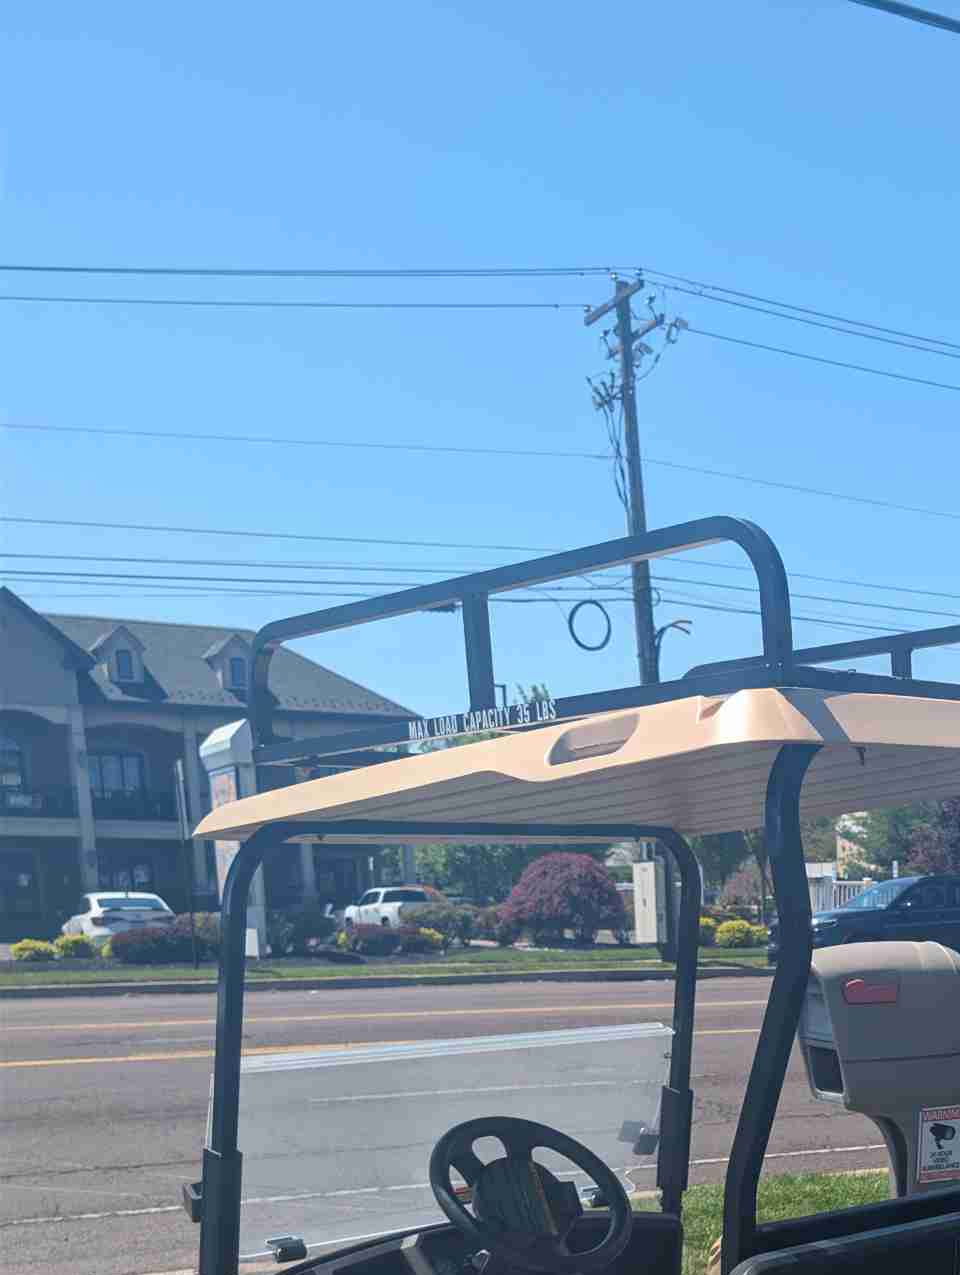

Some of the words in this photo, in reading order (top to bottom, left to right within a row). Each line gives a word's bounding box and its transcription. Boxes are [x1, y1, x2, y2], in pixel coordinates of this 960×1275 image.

[408, 720, 430, 741] MAX
[433, 714, 458, 736] LOAD
[463, 705, 511, 731] CAPACITY
[516, 703, 530, 724] 35
[536, 698, 556, 721] LBS
